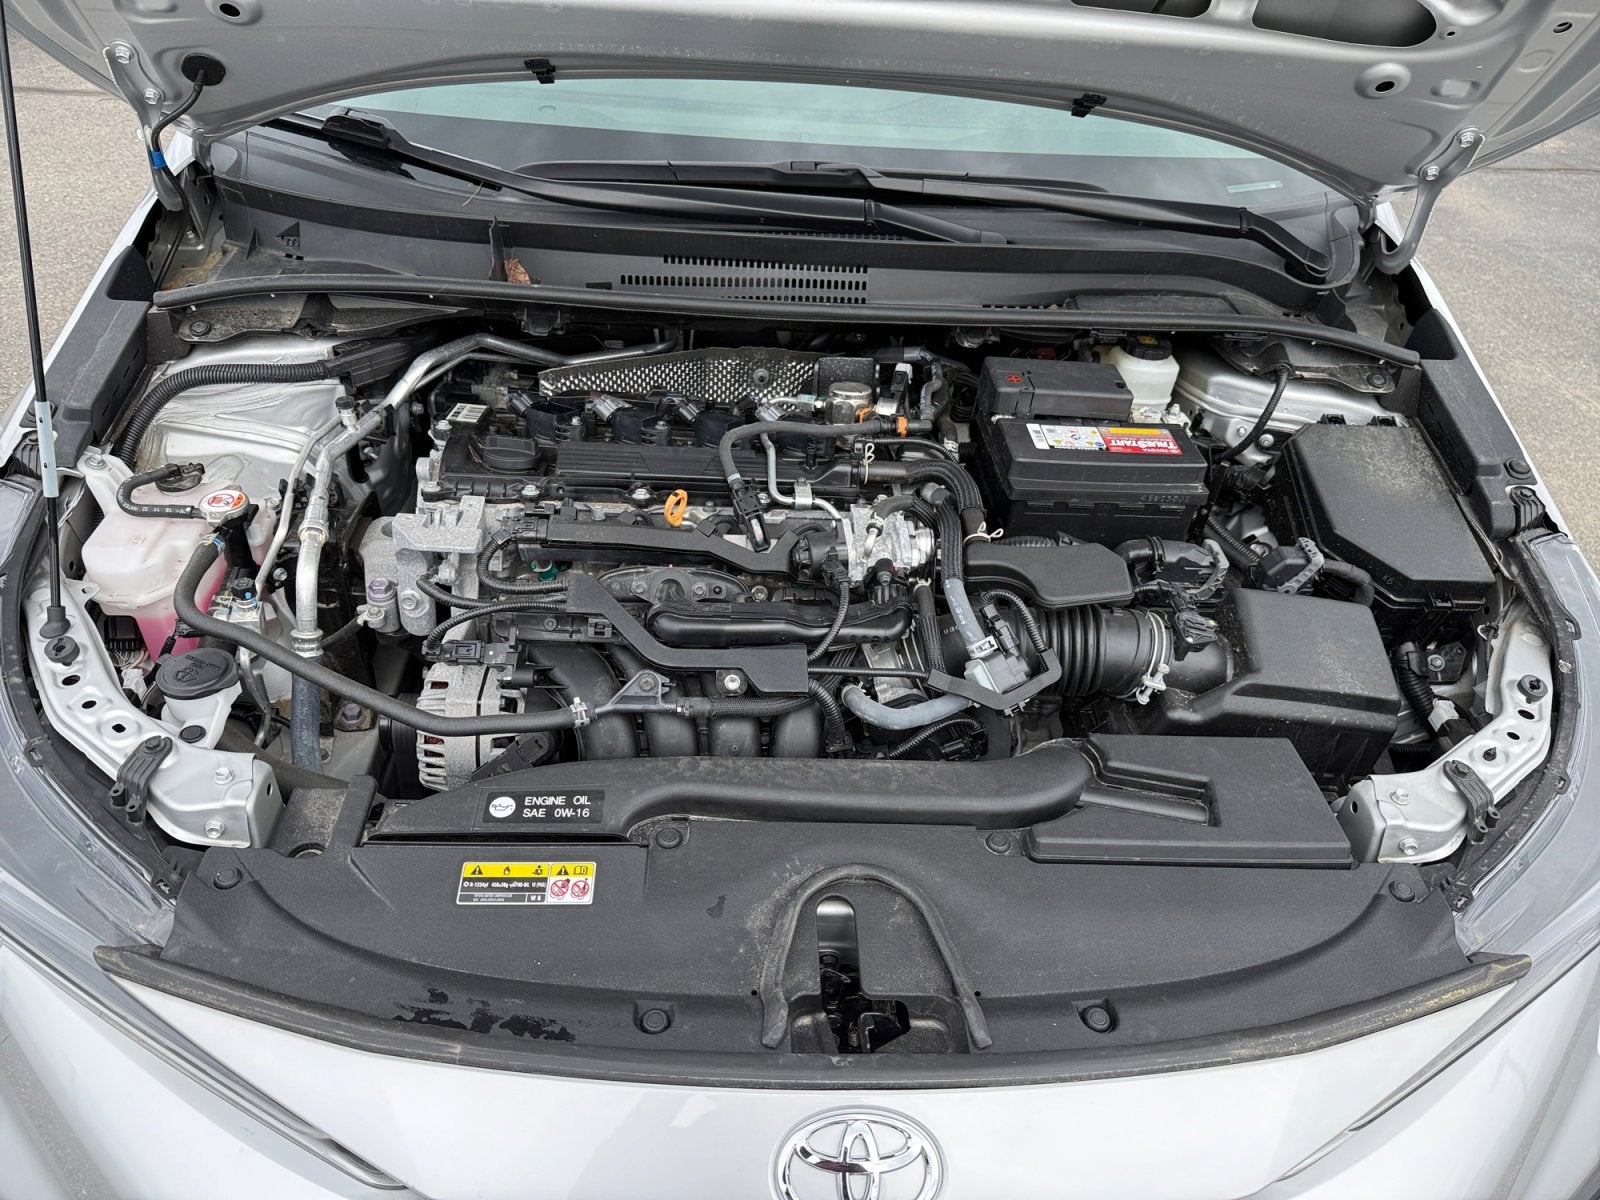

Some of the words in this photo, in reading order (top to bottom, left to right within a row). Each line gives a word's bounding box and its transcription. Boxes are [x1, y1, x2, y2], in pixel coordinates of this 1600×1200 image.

[524, 795, 567, 806] ENGINE
[573, 795, 592, 805] OIL
[522, 808, 547, 818] SAE
[554, 808, 590, 818] 0W-16
